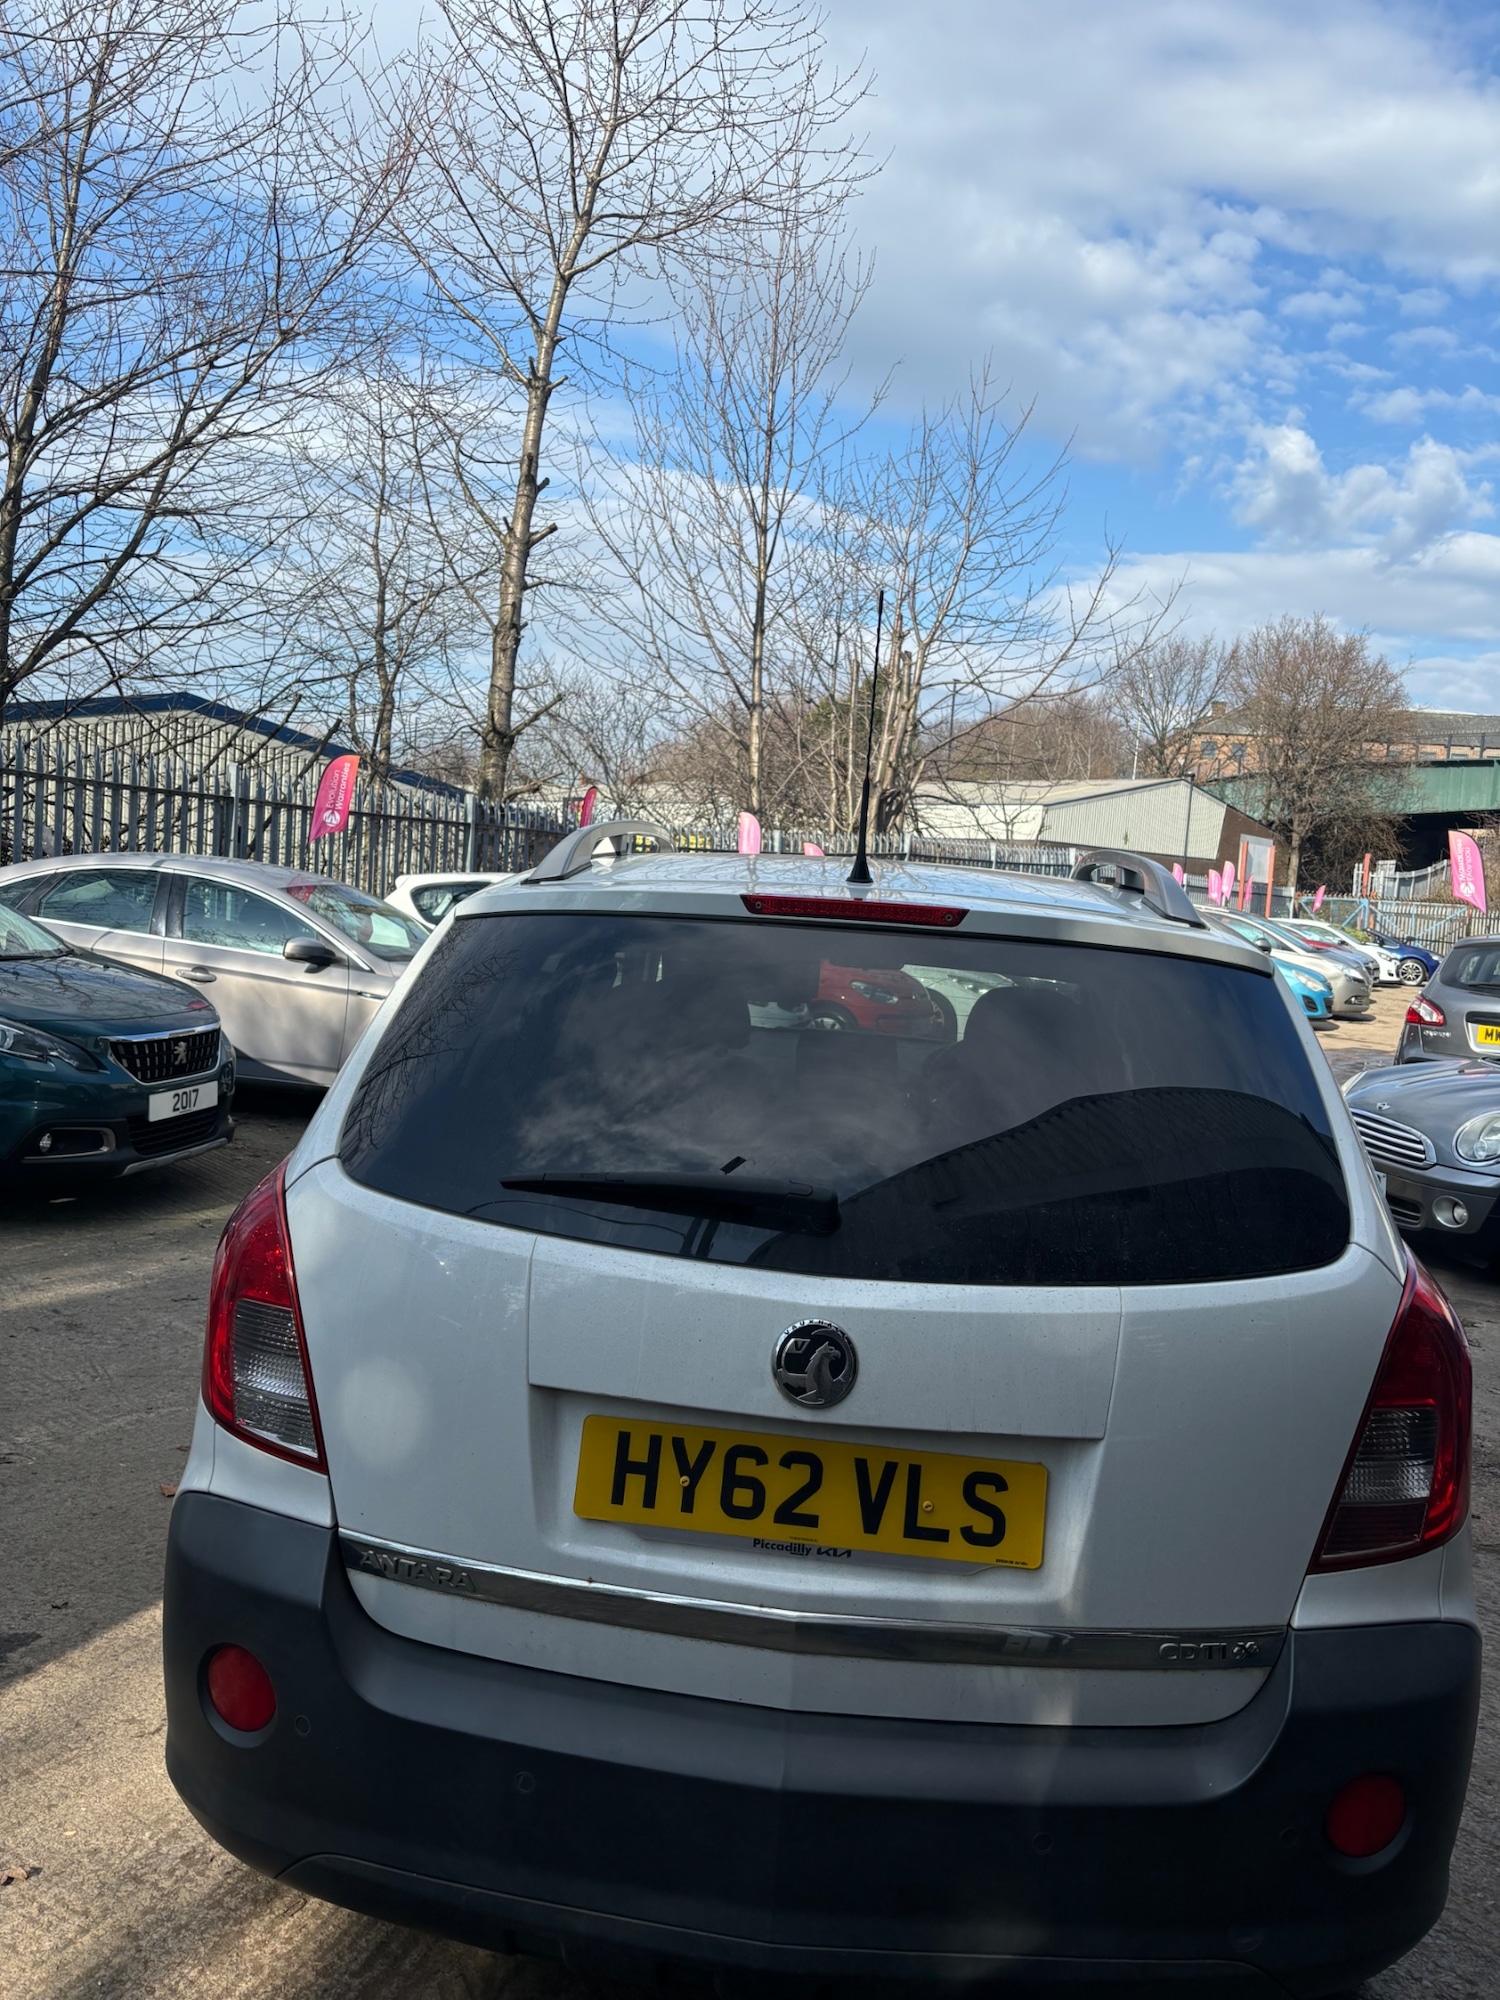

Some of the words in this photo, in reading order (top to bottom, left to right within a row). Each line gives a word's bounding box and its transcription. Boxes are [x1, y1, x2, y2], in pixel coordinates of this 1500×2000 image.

[326, 769, 340, 808] Evolution
[335, 762, 351, 810] Warranties
[172, 1088, 199, 1112] 2017
[611, 1431, 824, 1528] HY62
[854, 1457, 1009, 1548] VLS
[753, 1538, 812, 1556] Piccadilly
[360, 1550, 477, 1592] ANTARA
[1159, 1642, 1228, 1659] CDTI
